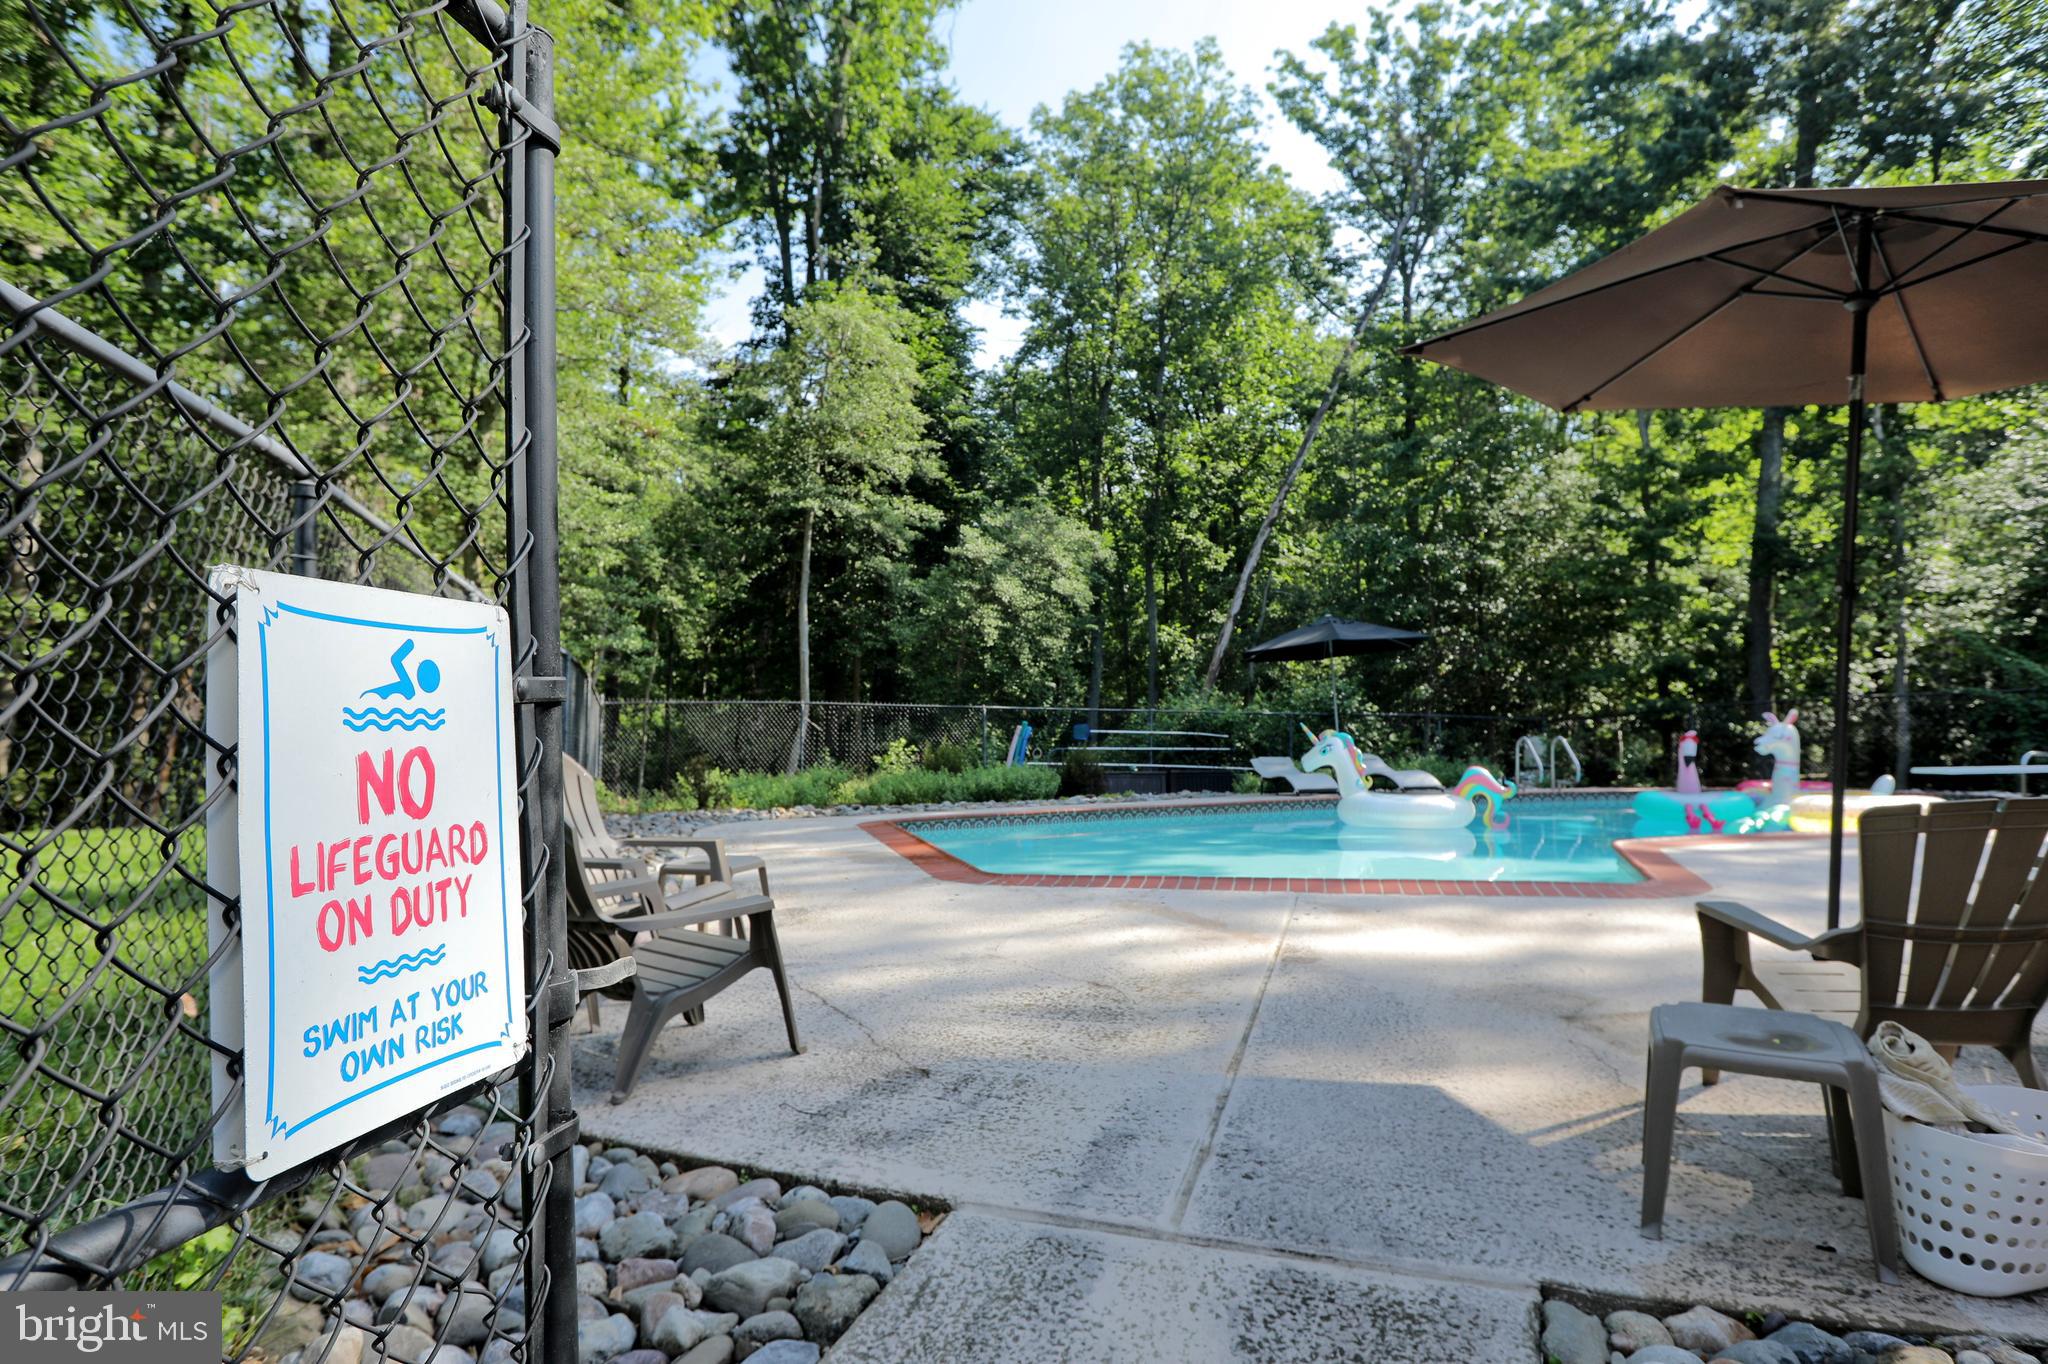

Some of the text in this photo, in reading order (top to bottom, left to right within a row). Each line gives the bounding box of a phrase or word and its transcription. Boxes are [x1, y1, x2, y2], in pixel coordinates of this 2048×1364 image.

[355, 745, 436, 825] NO
[289, 820, 488, 899] LIFEGUARD
[316, 873, 473, 953] ON DUTY
[303, 971, 489, 1058] SWIM AT YOUR
[340, 1033, 405, 1082] OWN
[415, 1011, 465, 1053] RISK
